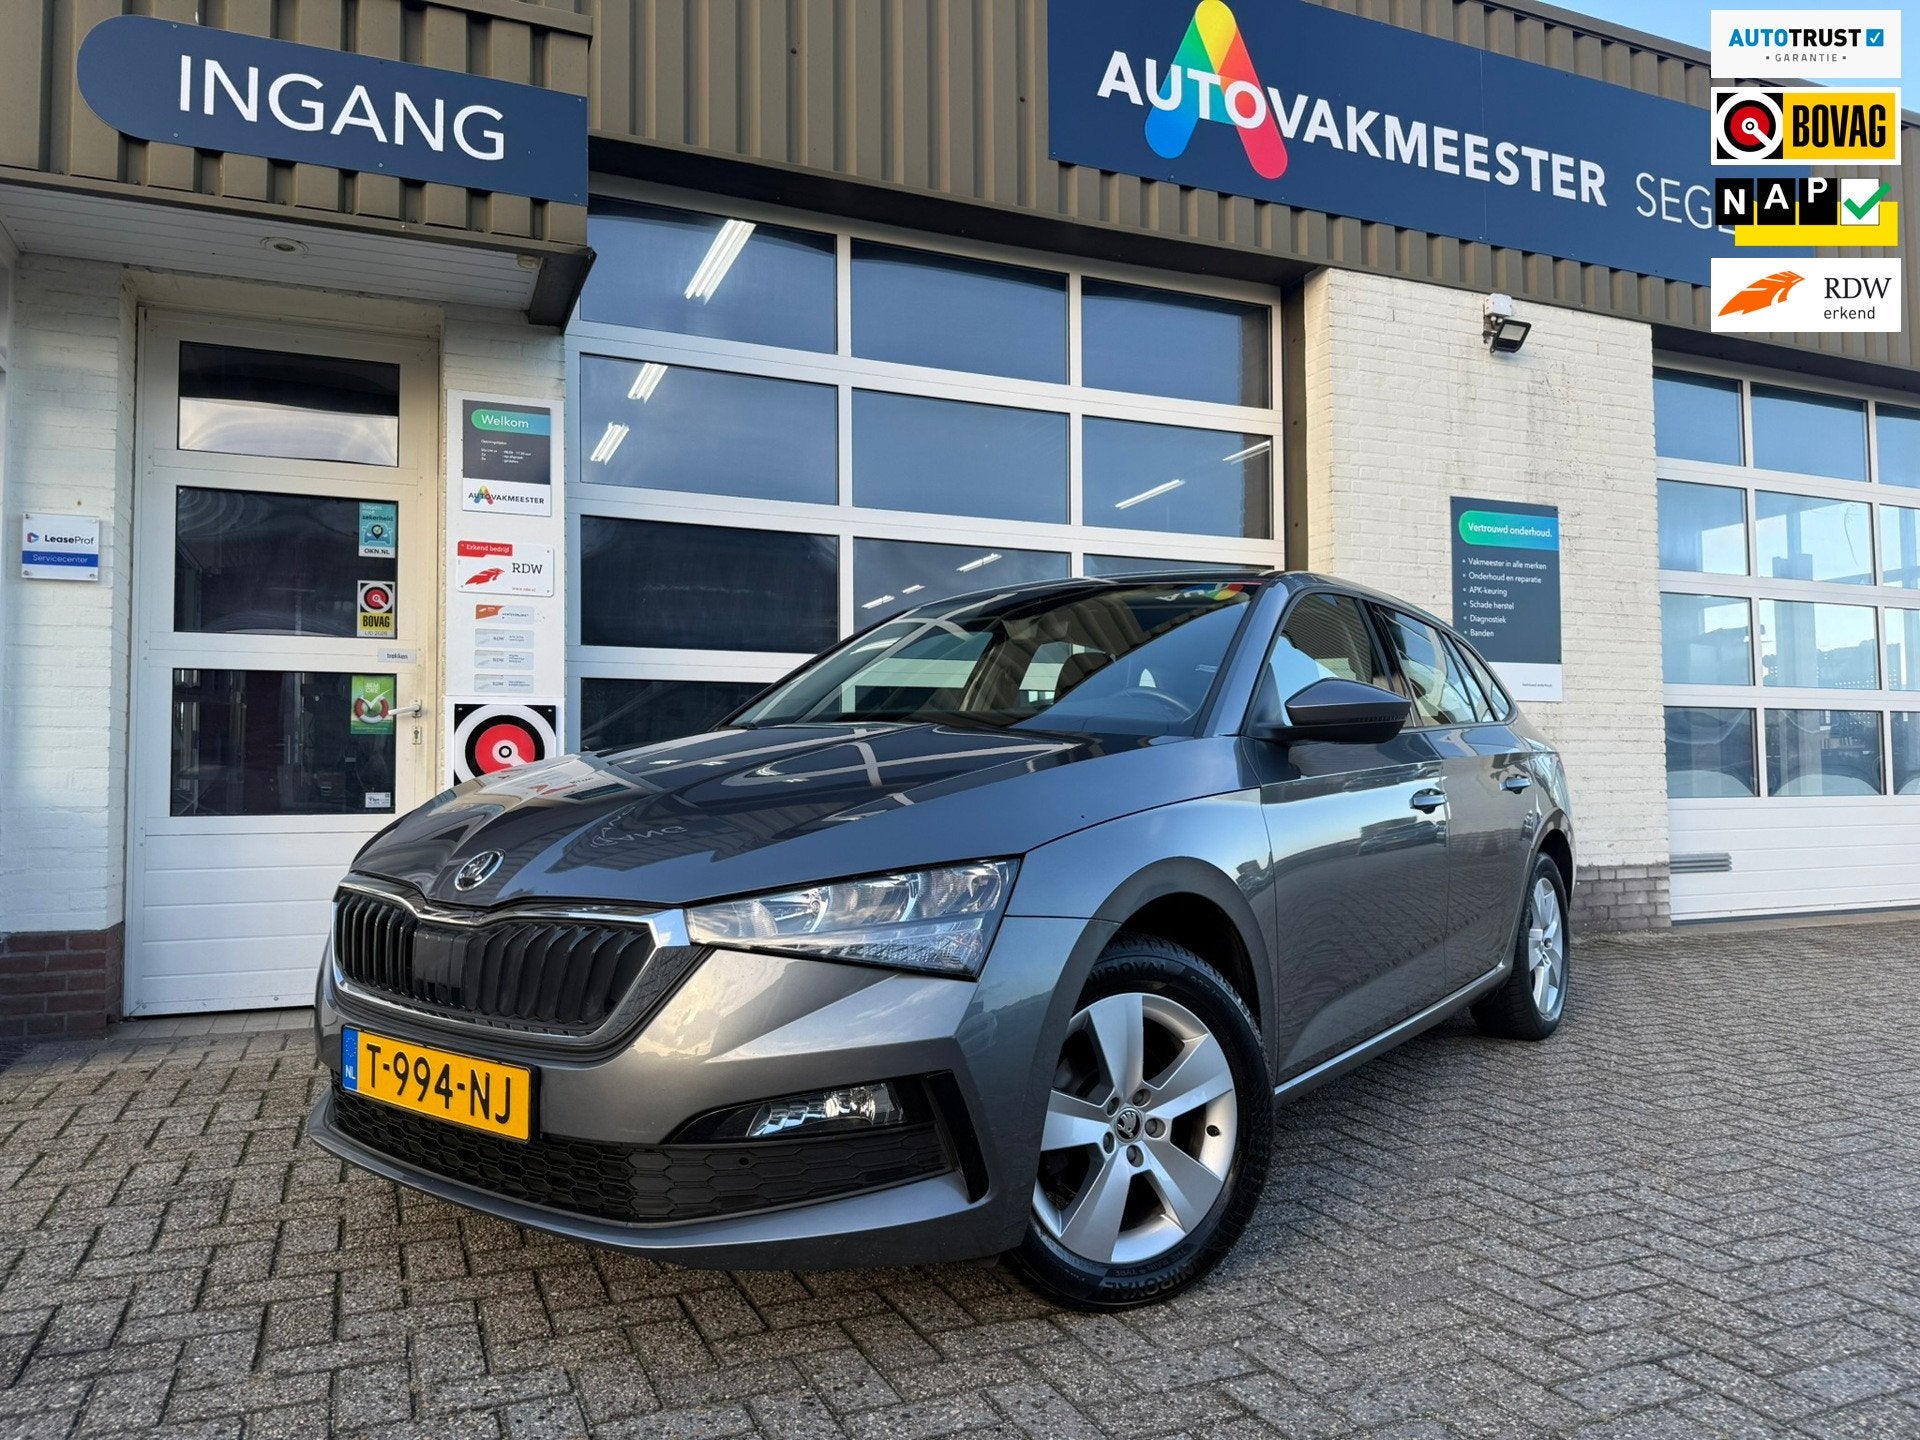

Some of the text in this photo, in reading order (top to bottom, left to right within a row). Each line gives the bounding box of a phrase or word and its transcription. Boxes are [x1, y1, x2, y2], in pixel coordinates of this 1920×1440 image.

[179, 54, 505, 162] INGANG
[1097, 50, 1736, 235] AUTOVAKMEESTER SEG
[480, 413, 529, 428] Welkom
[468, 491, 545, 505] AUTOVAKMEESTER
[1467, 521, 1553, 538] Vertrouwd onderhoud.
[44, 534, 95, 545] LeaseProf
[363, 547, 391, 555] OKN.NL
[466, 543, 510, 554] Erkend bedrijf
[32, 553, 89, 564] Servicecenter
[1468, 557, 1547, 571] Vakmeester in alle merken
[511, 562, 543, 575] RDW
[1468, 571, 1542, 584] Onderhoud en reparatie
[1469, 586, 1507, 597] APK-keuring
[1469, 600, 1515, 611] Schade herstel
[362, 615, 390, 628] BOVAG
[1470, 614, 1507, 625] Diagnostiek
[1470, 628, 1494, 638] Banden
[345, 1064, 356, 1080] NL
[366, 1042, 511, 1125] T-994-NJ
